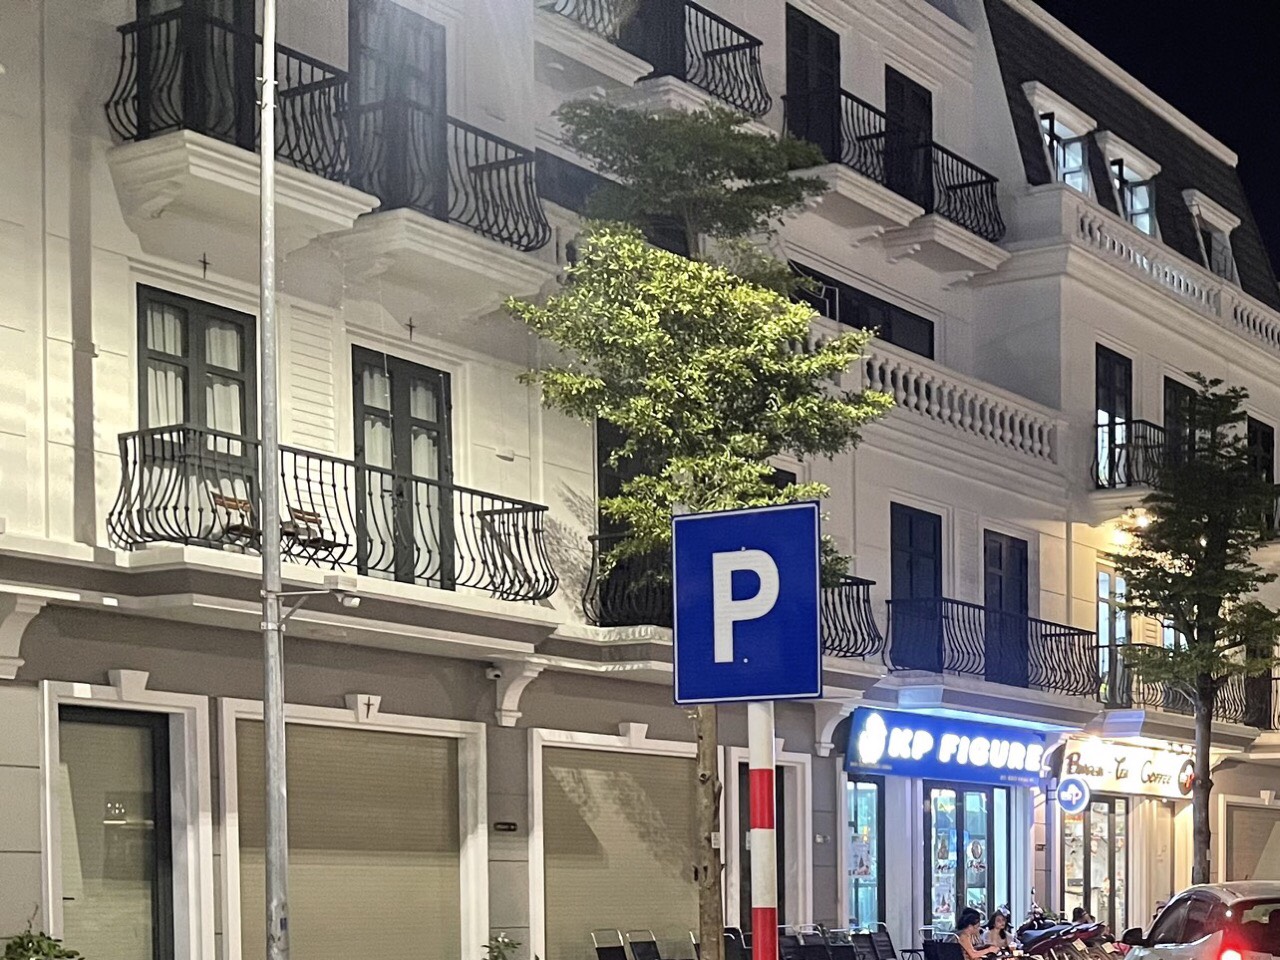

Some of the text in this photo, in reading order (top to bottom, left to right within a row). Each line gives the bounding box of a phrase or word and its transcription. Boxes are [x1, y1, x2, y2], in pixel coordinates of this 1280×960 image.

[712, 549, 781, 664] P
[887, 727, 934, 761] KP
[938, 733, 1044, 772] FIGURE
